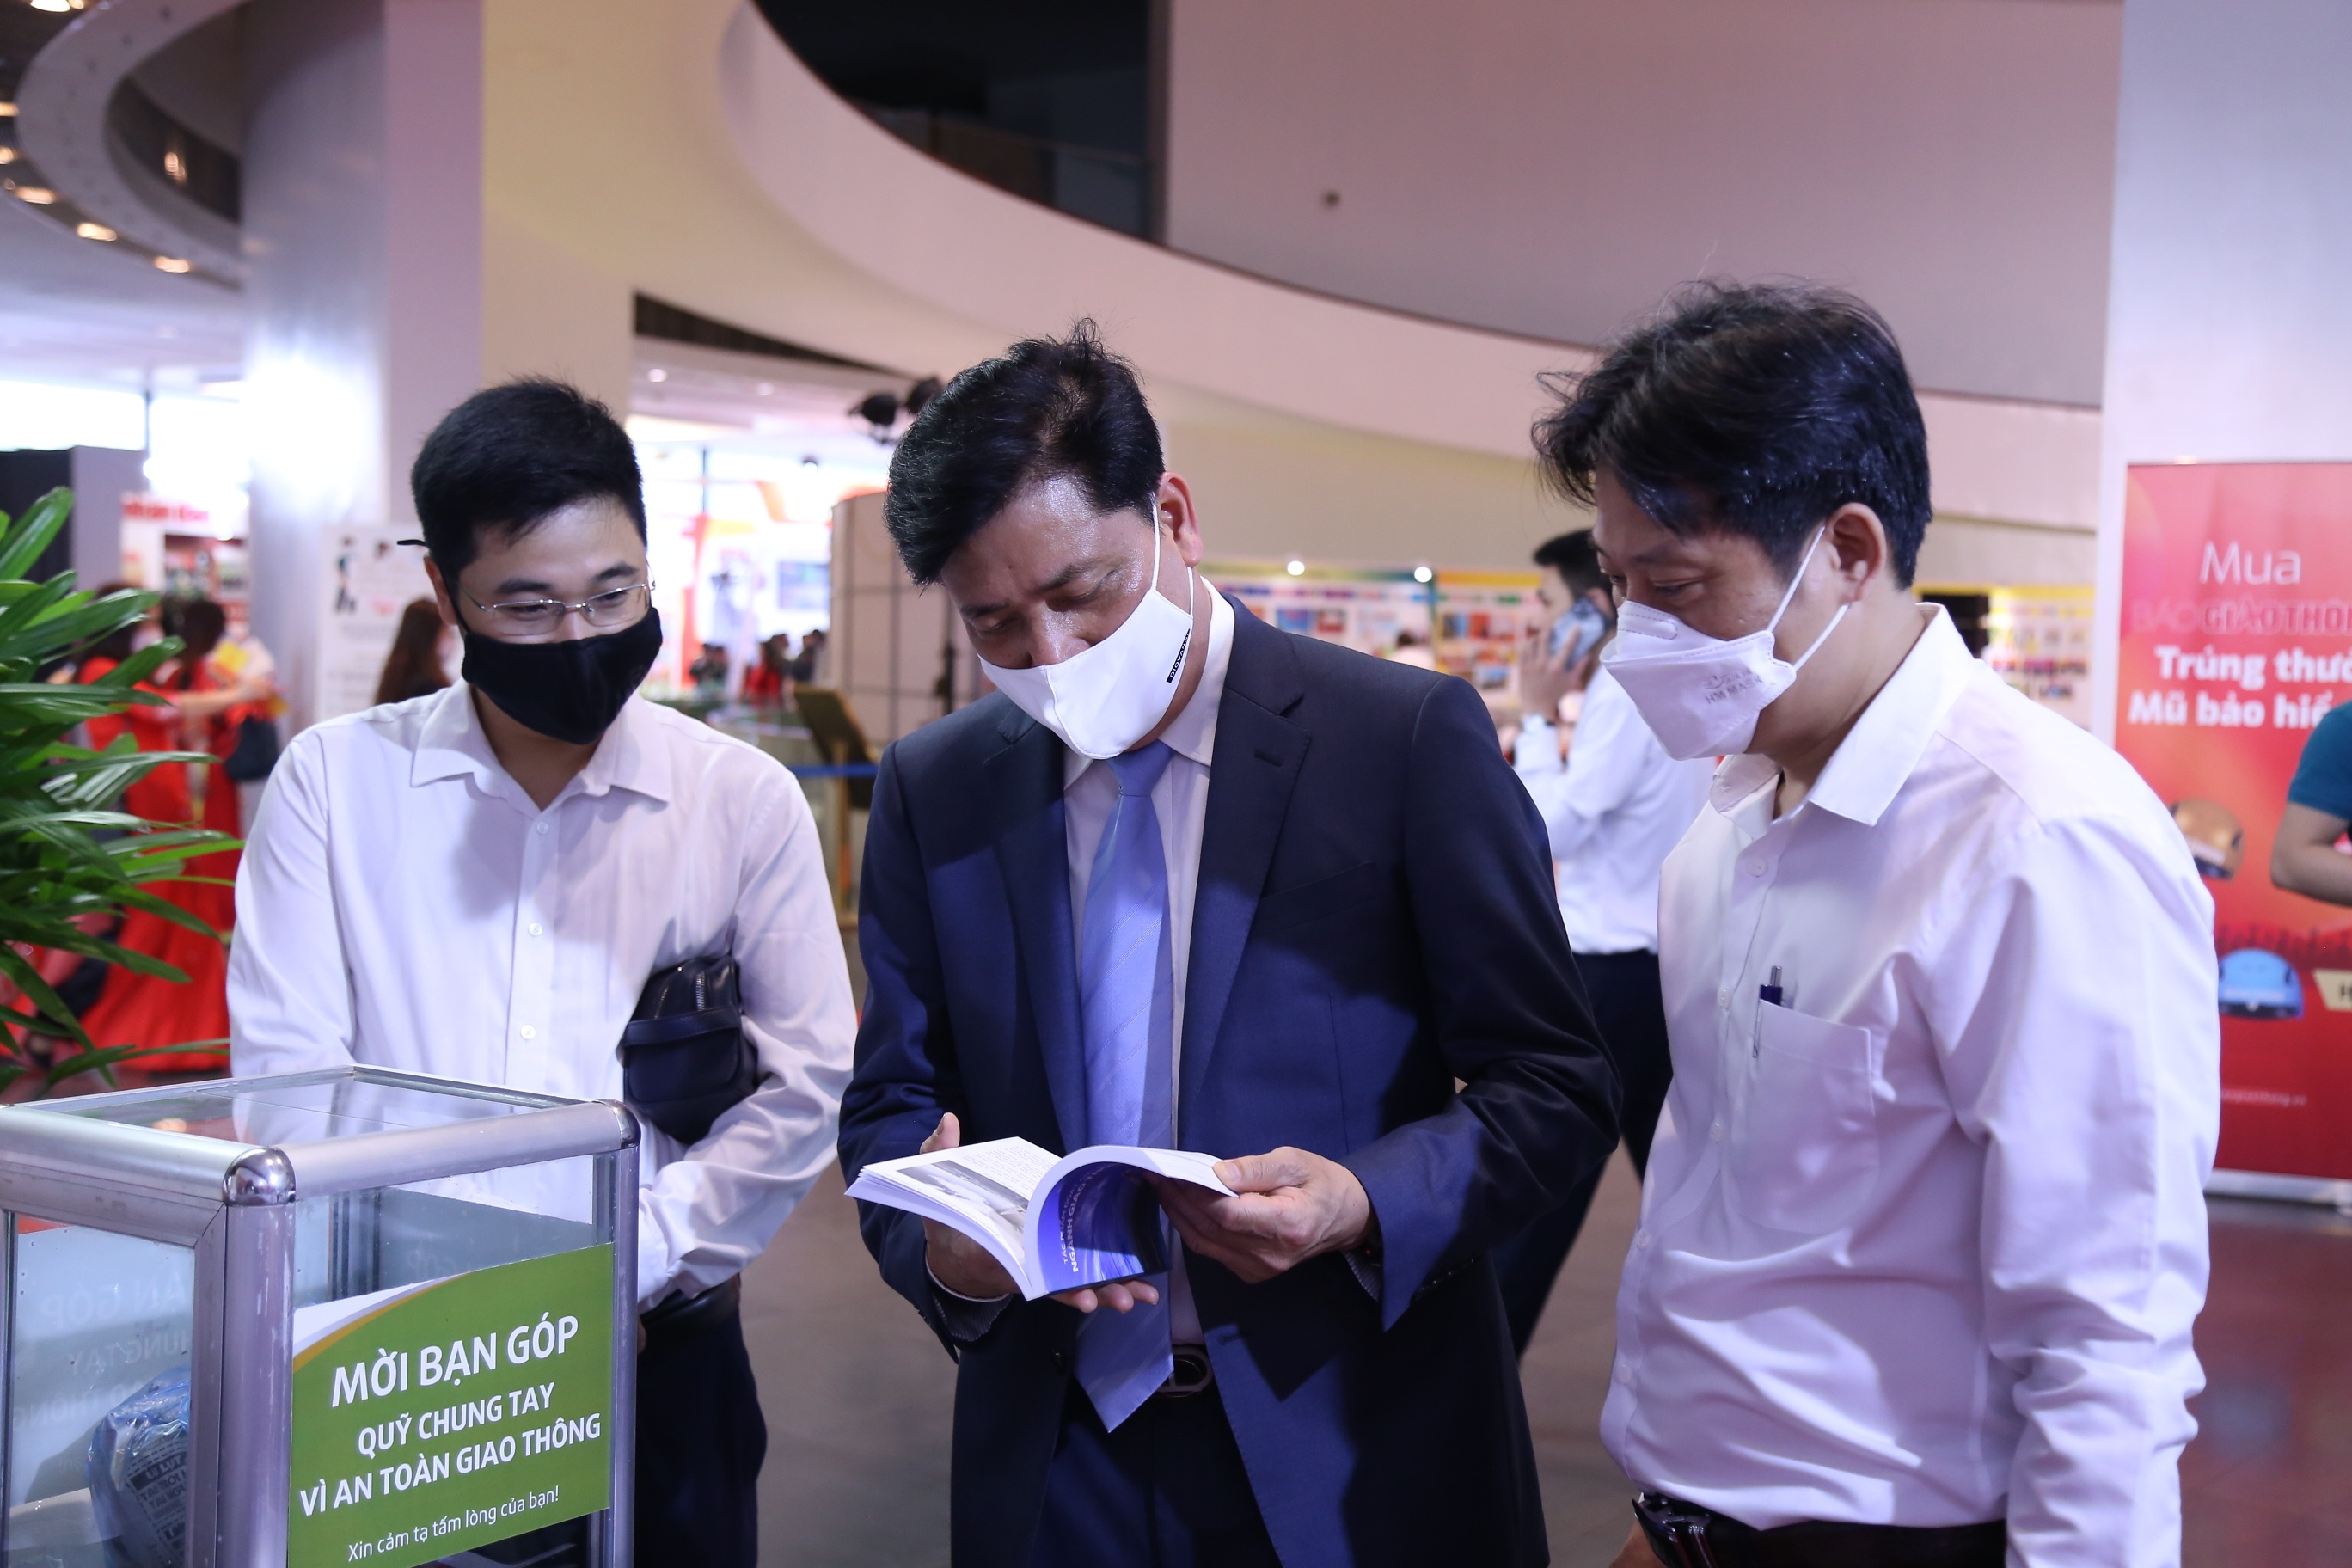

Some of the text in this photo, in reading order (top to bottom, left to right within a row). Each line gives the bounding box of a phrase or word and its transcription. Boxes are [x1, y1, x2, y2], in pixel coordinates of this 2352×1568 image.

[2199, 540, 2302, 585] Mua
[2153, 644, 2267, 691] Trúng
[2128, 689, 2189, 726] Mũ
[331, 1311, 579, 1407] MỜI BẠN GÓP
[358, 1381, 556, 1459] QUỸ CHUNG TAY
[299, 1412, 602, 1517] VÌ AN TOÀN GIAO THÔNG
[347, 1485, 560, 1563] Xin cảm tạ tấm lòng của bạn!
